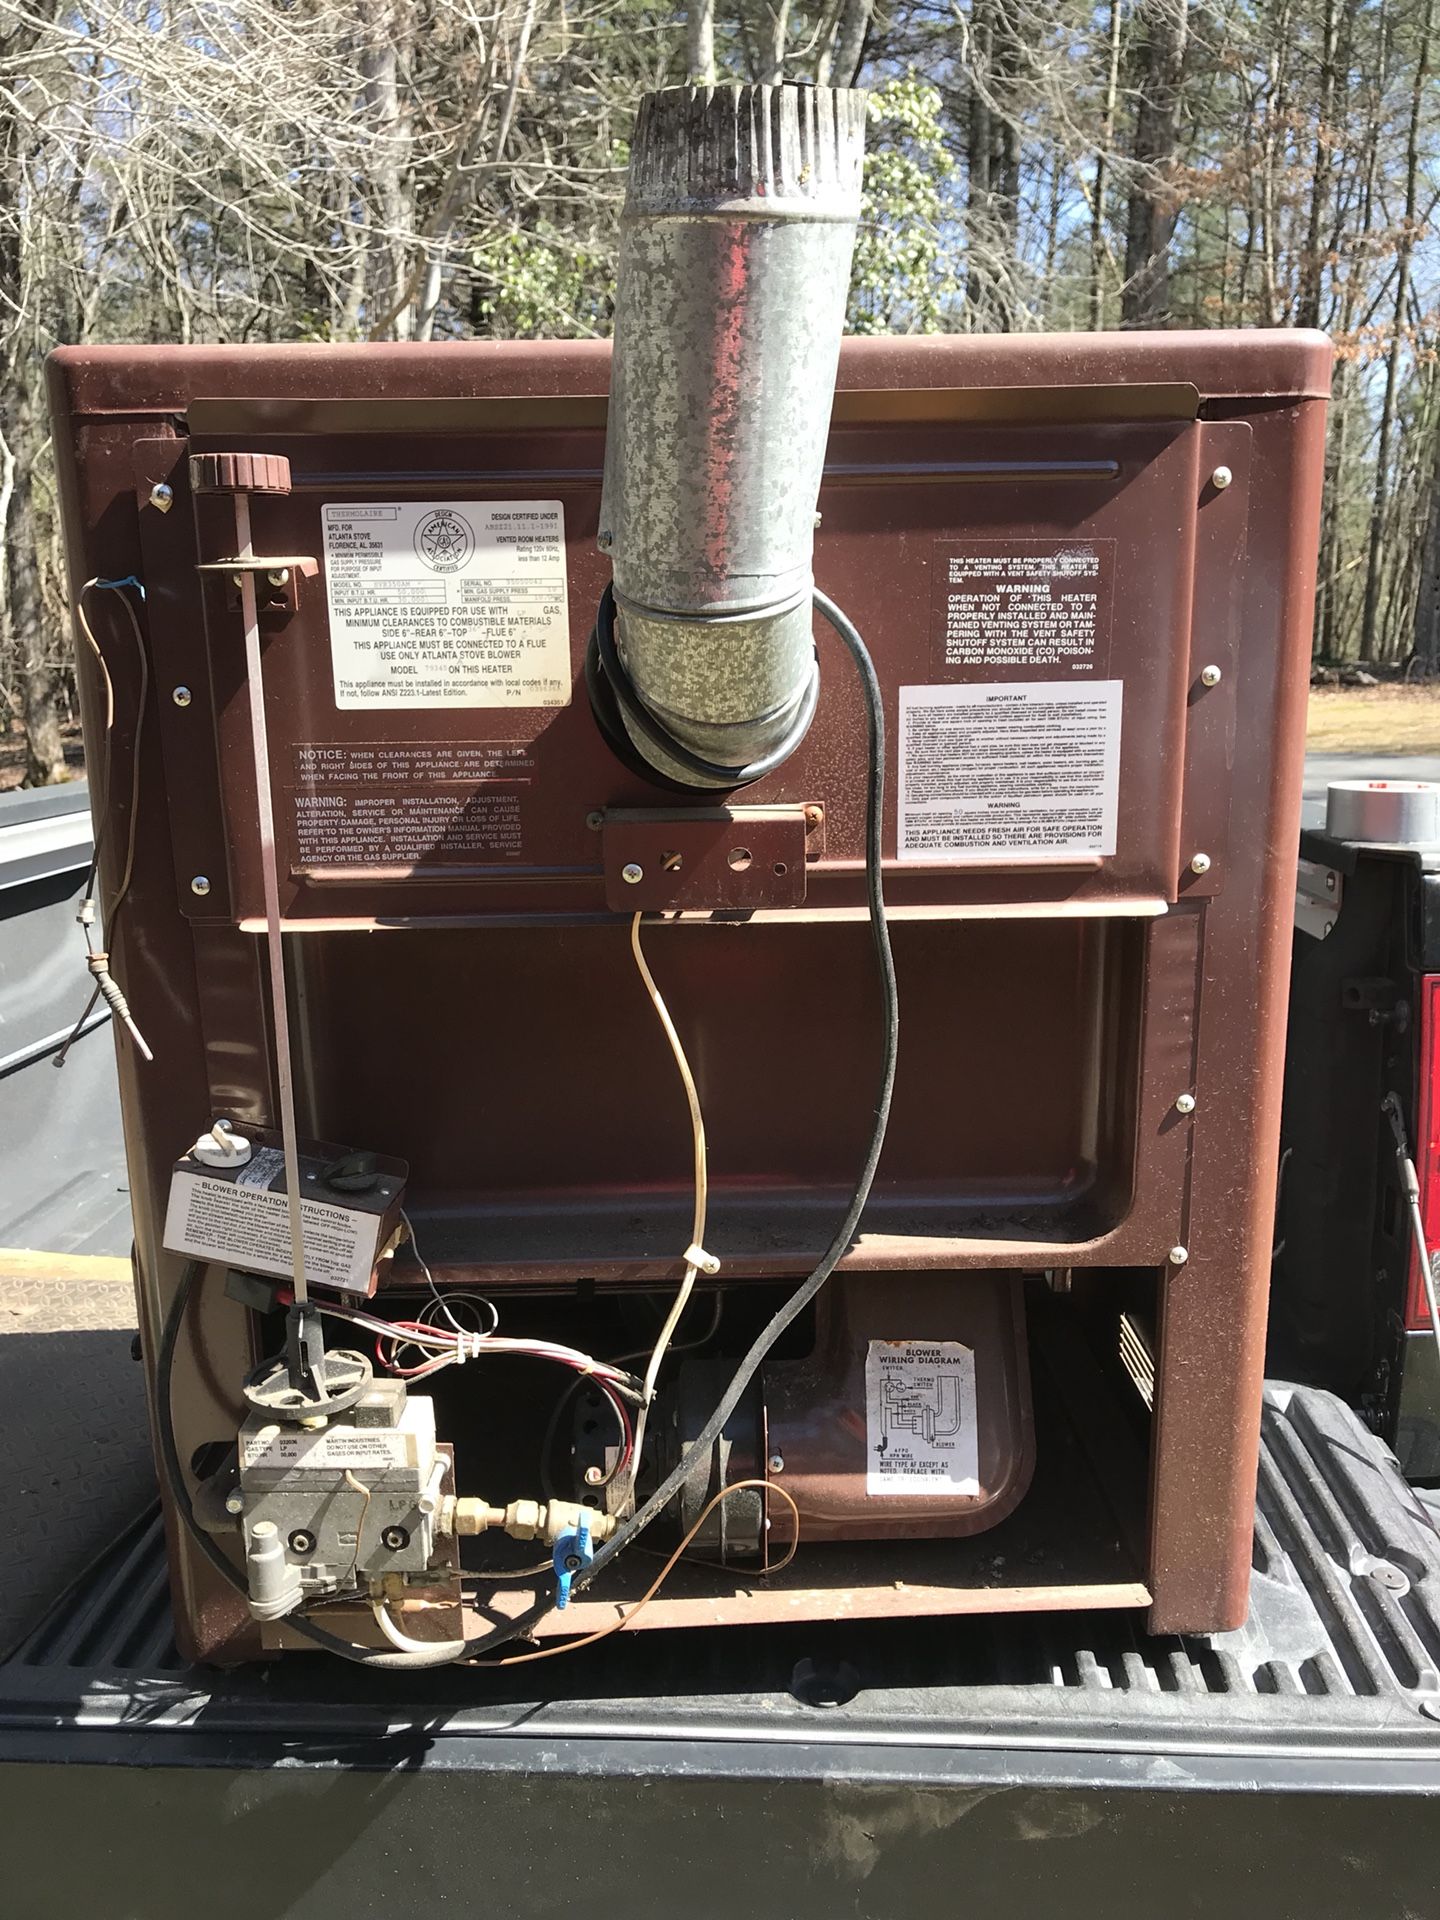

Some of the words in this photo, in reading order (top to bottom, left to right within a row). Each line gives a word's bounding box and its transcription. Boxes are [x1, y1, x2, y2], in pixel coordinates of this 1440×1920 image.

[996, 585, 1050, 593] WARNING
[334, 608, 351, 616] THIS
[354, 608, 397, 616] APPLIANCE
[400, 608, 407, 616] IS
[410, 607, 449, 616] EQUIPPED
[451, 607, 468, 615] FOR
[470, 607, 485, 615] USE
[488, 607, 508, 615] WITH
[543, 606, 562, 615] GAS,
[345, 619, 380, 627] MINIMUM
[381, 618, 434, 627] CLEARANCES
[437, 618, 447, 626] TO
[449, 618, 504, 626] COMBUSTIBLE
[507, 618, 552, 626] MATERIALS
[382, 629, 399, 637] SIDE
[373, 641, 416, 649] APPLIANCE
[419, 641, 440, 649] MUST
[455, 640, 503, 648] CONNECTED
[506, 640, 516, 648] TO
[518, 640, 524, 648] A
[526, 640, 546, 648] FLUE
[380, 651, 395, 660] USE
[398, 651, 418, 660] ONLY
[421, 651, 457, 659] ATLANTA
[459, 651, 484, 659] STOVE
[487, 650, 521, 659] BLOWER
[390, 666, 418, 674] MODEL
[448, 666, 460, 674] ON
[462, 665, 479, 674] THIS
[481, 665, 512, 673] HEATER
[339, 680, 353, 689] This
[355, 680, 385, 689] appliance
[387, 680, 403, 688] must
[405, 680, 413, 688] be
[415, 680, 442, 688] installed
[443, 680, 449, 688] in
[451, 679, 488, 688] accordance
[490, 679, 503, 688] with
[505, 679, 520, 688] local
[522, 679, 541, 688] codes
[549, 679, 563, 688] any.
[299, 750, 347, 760] NOTICE:
[295, 797, 347, 807] WARNING:
[402, 797, 460, 805] INSTALLATION,
[202, 1182, 238, 1196] BLOWER
[240, 1190, 288, 1208] OPERATION
